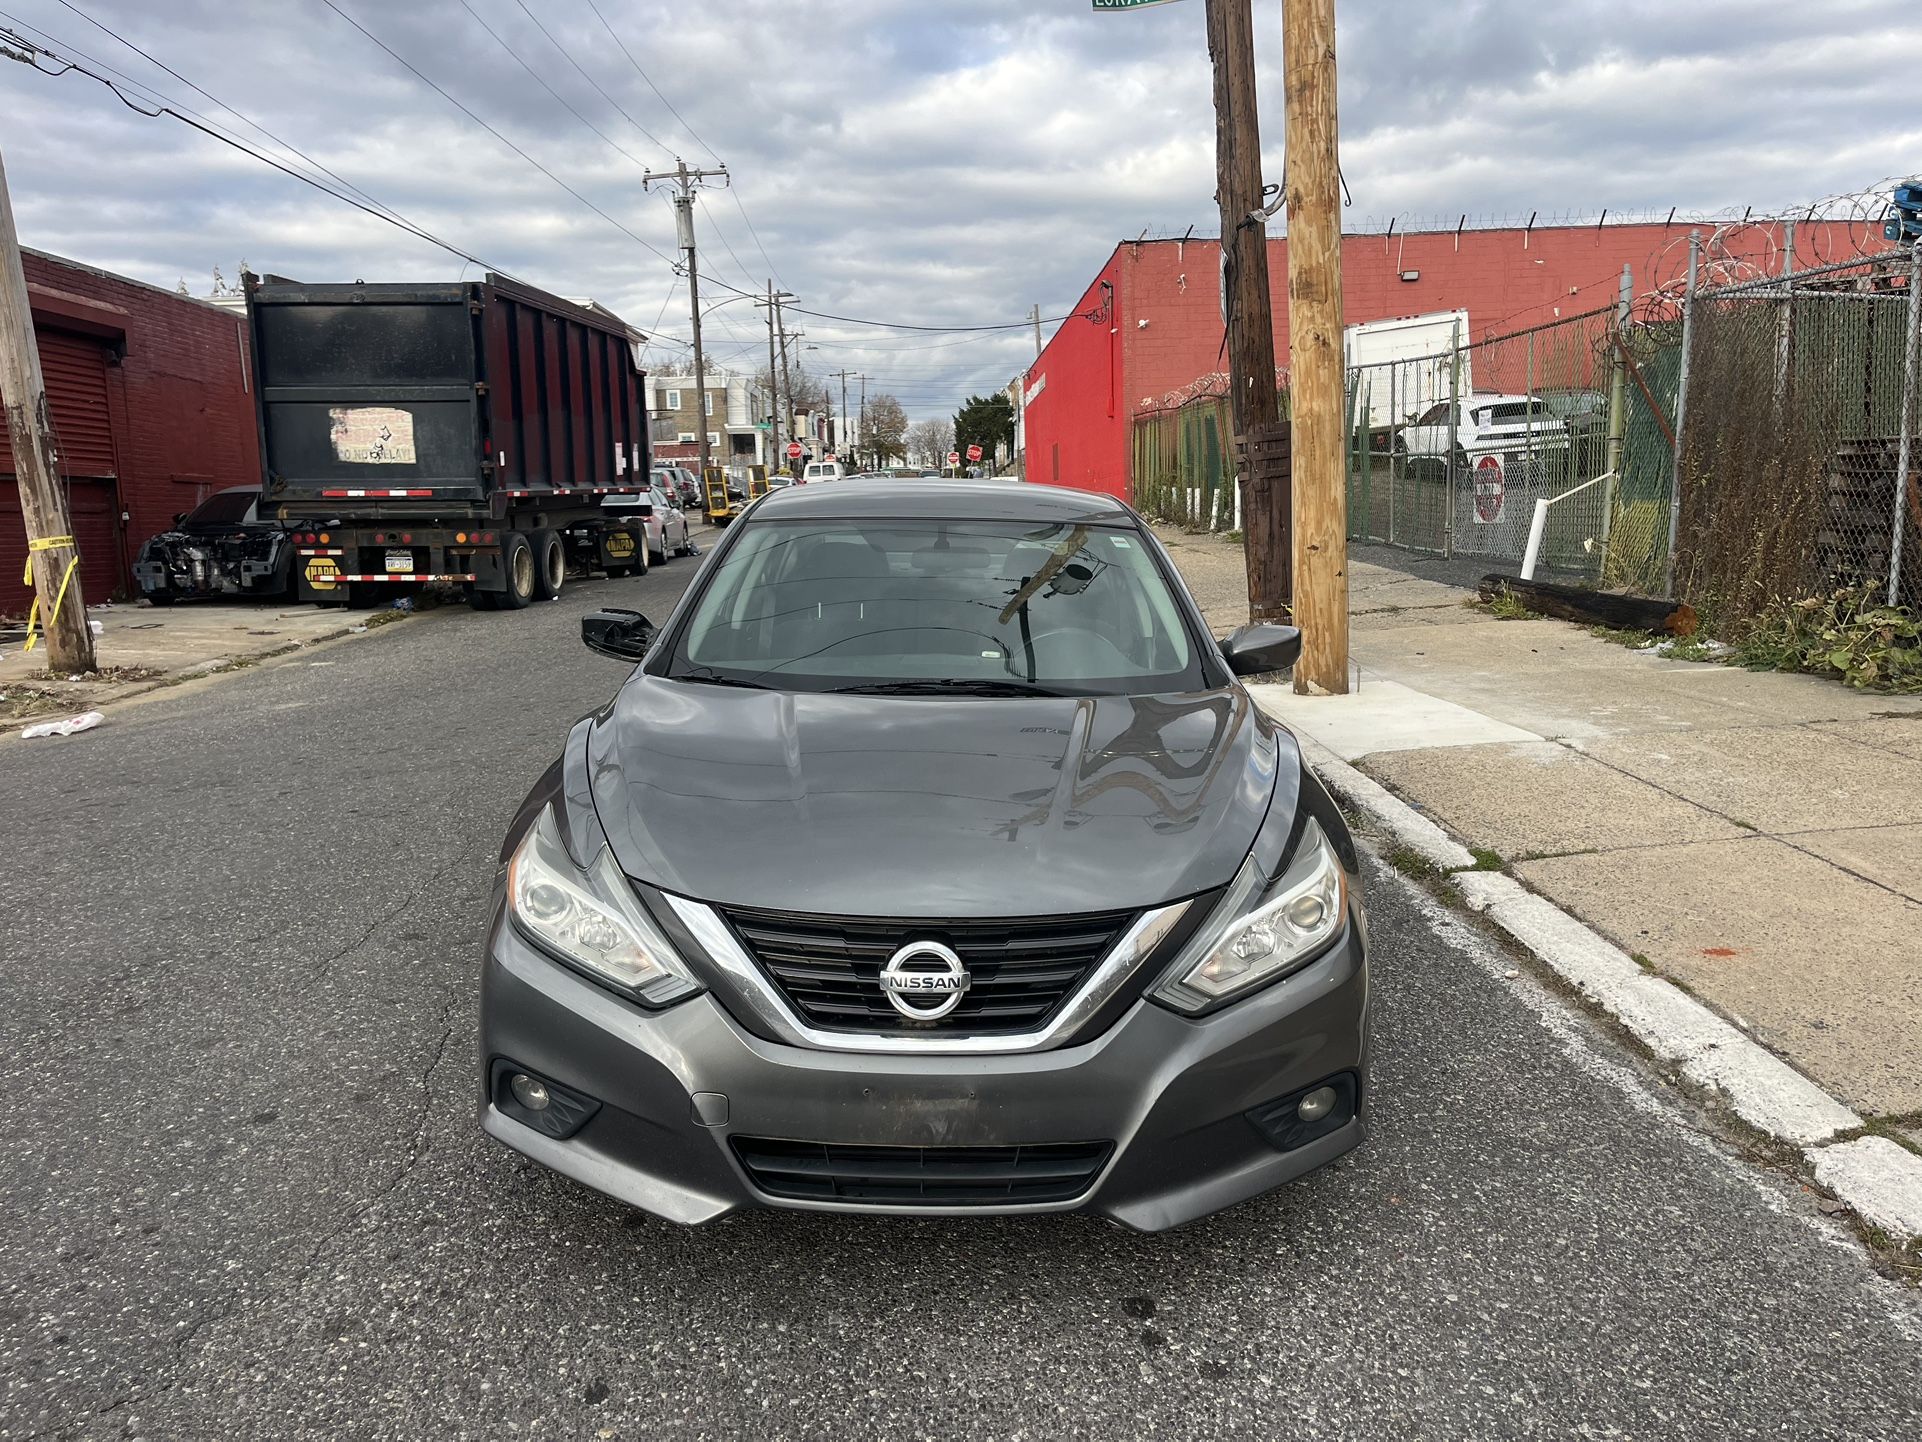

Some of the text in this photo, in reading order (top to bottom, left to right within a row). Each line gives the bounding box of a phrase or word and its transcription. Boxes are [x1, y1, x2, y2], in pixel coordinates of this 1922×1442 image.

[967, 449, 982, 457] STOP
[610, 538, 630, 551] NAPA
[310, 566, 335, 580] NAPA
[889, 976, 961, 989] NISSAN
